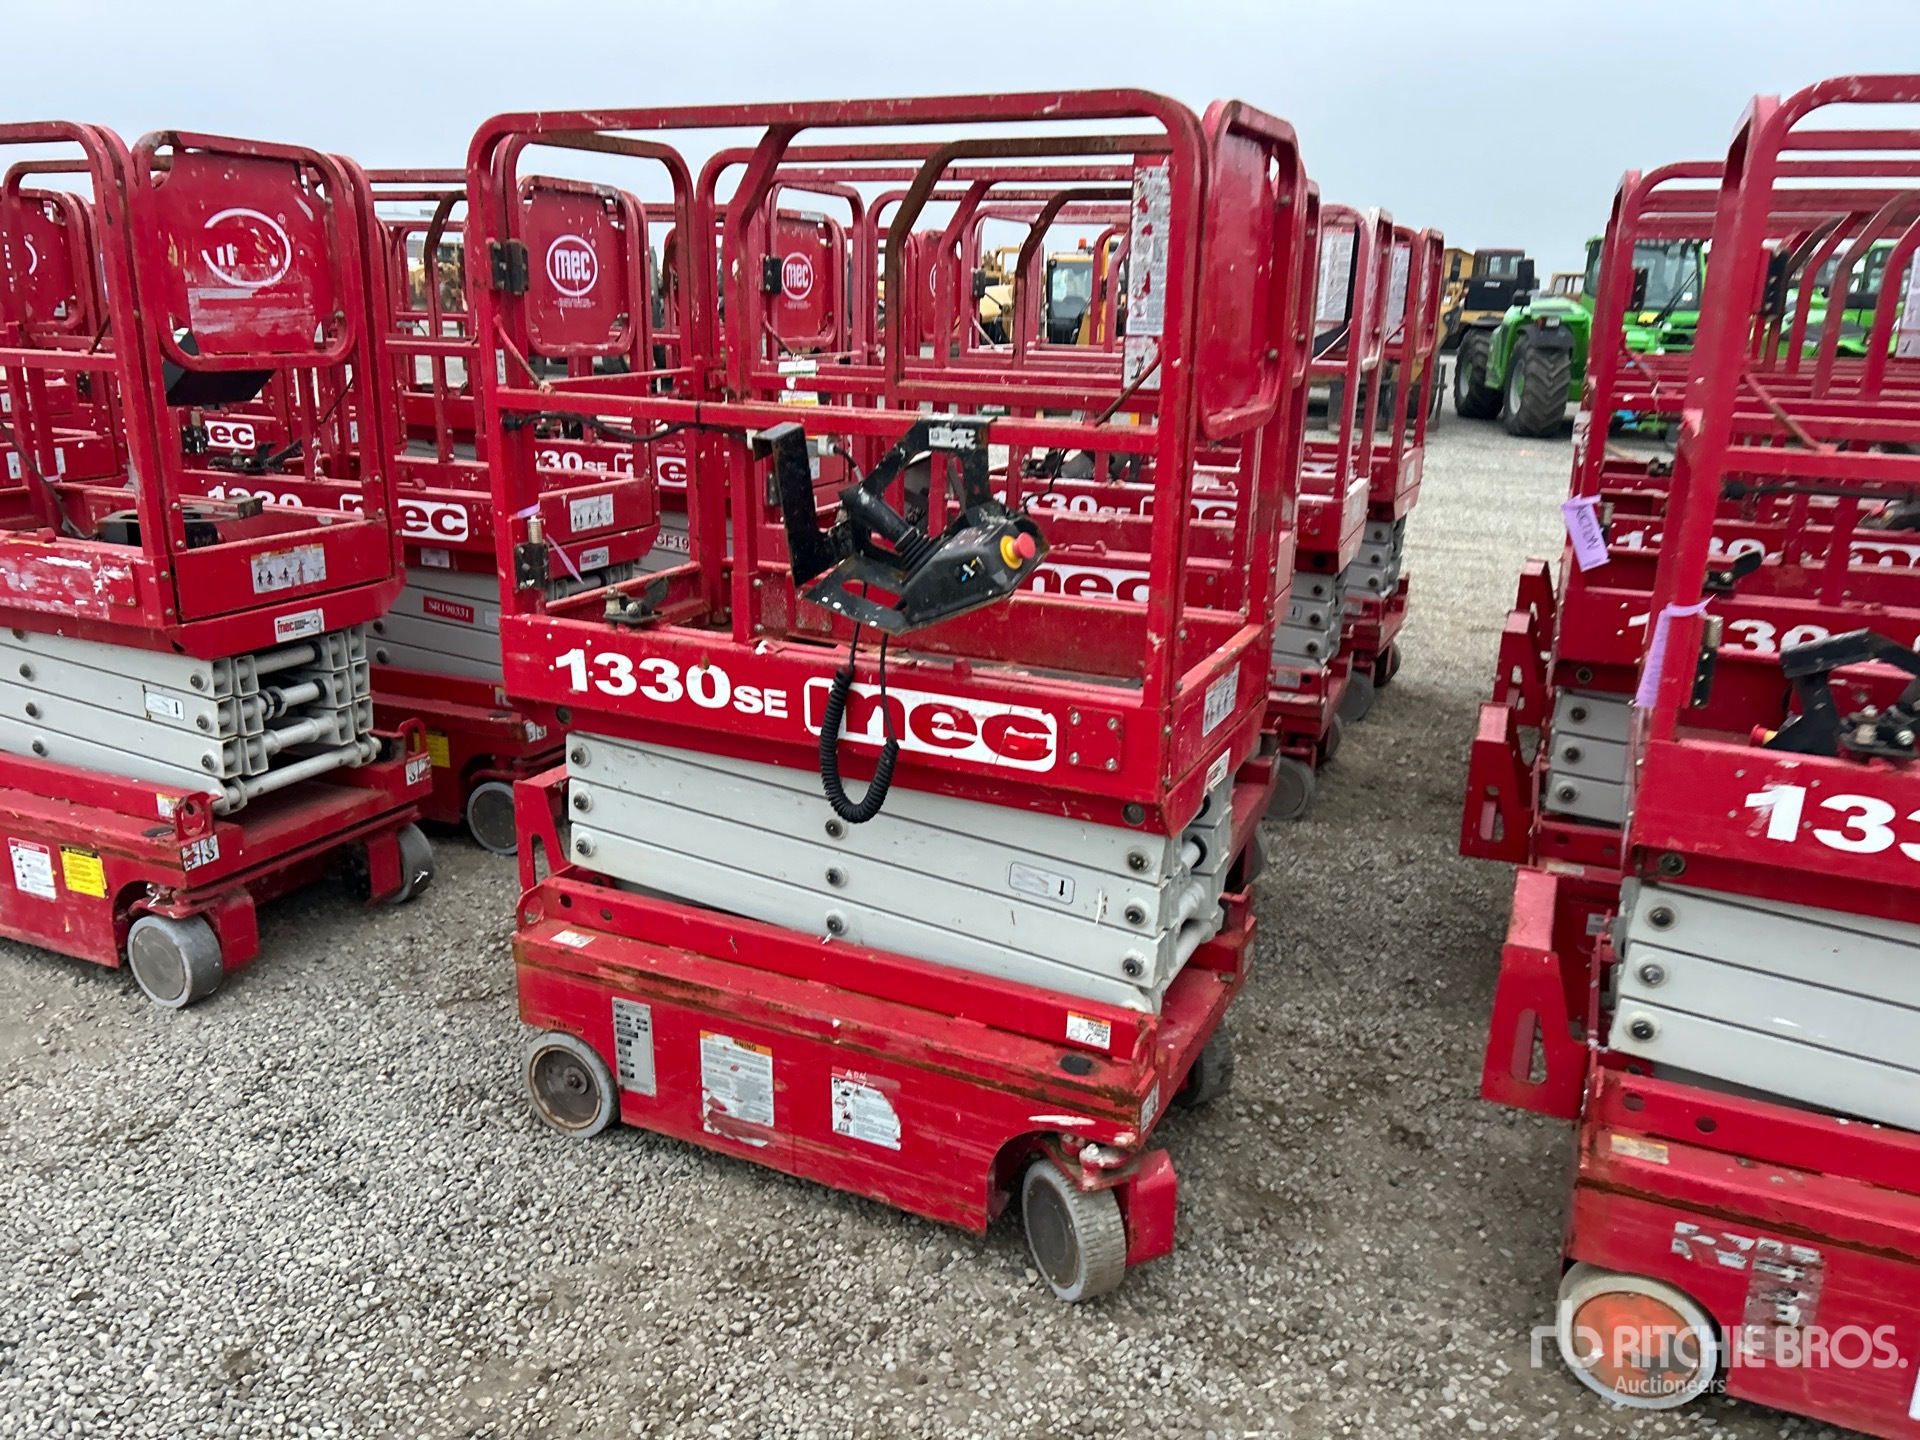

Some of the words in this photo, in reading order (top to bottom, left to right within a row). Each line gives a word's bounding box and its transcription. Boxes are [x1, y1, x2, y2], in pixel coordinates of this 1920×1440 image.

[555, 249, 590, 281] mec
[786, 263, 809, 288] mec
[210, 425, 254, 446] ec
[1745, 784, 1920, 862] 13
